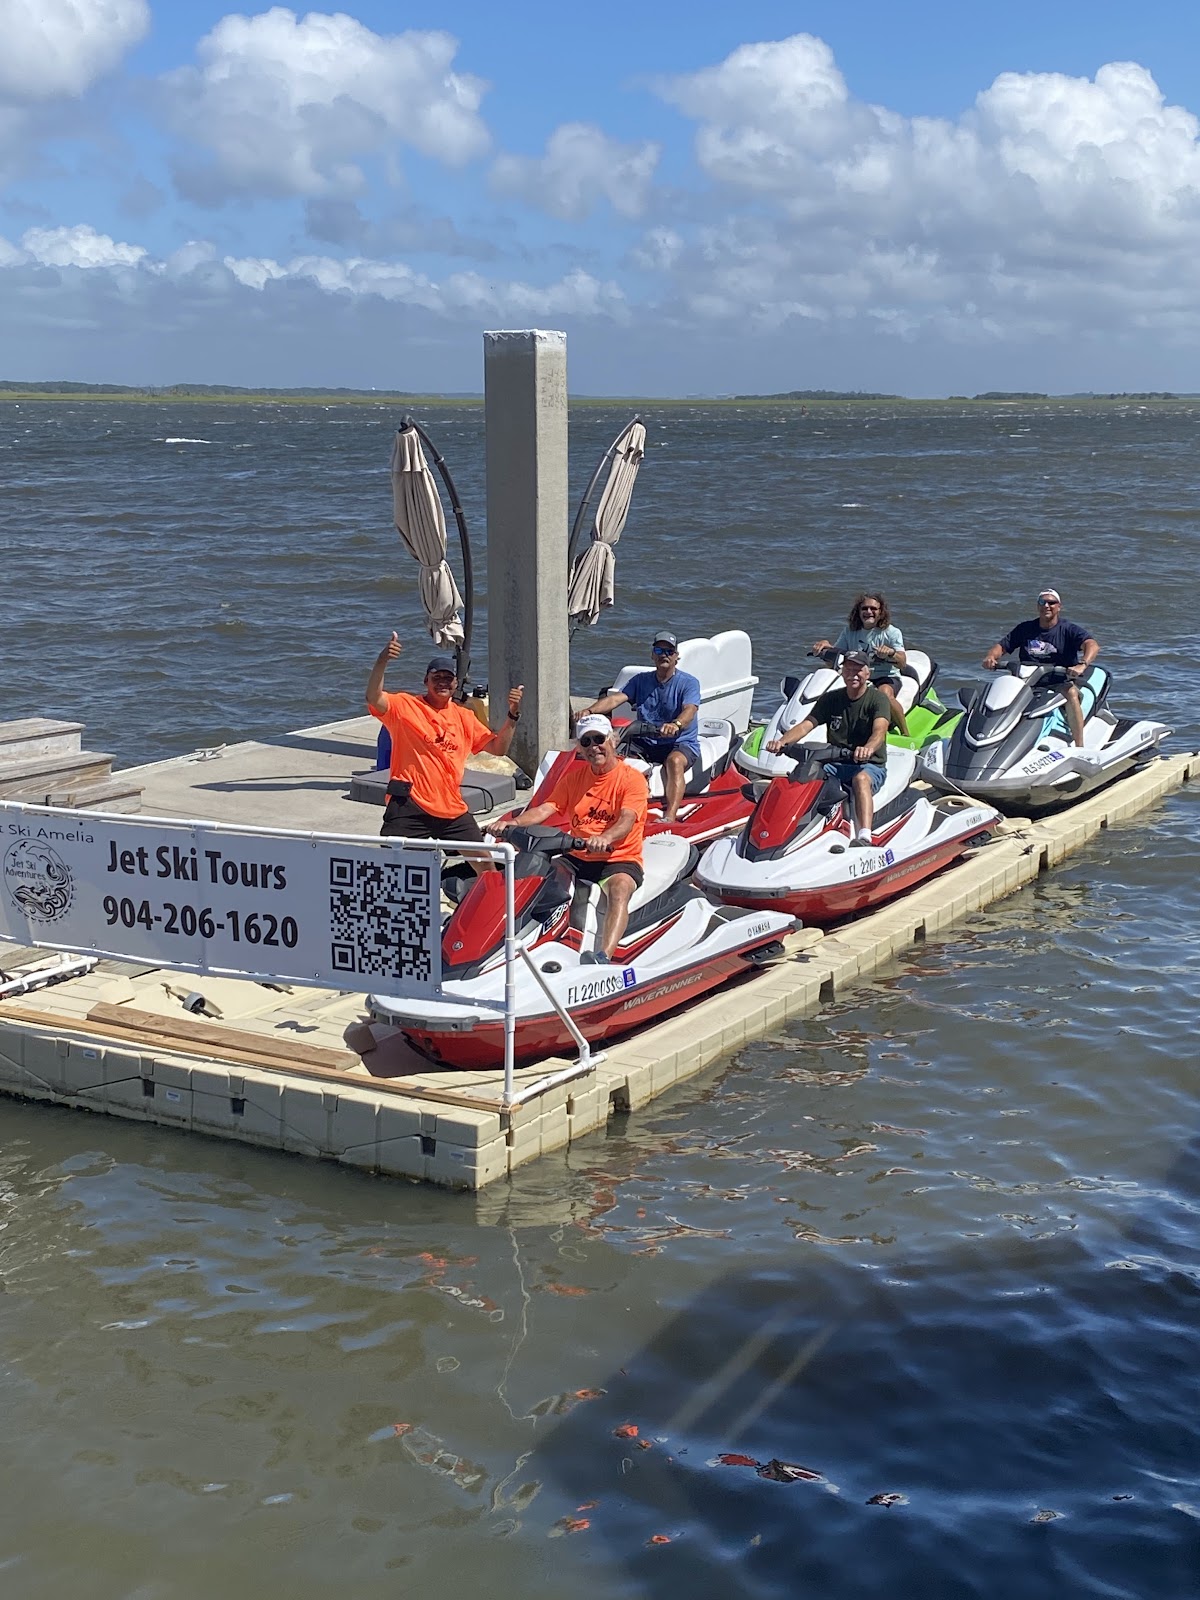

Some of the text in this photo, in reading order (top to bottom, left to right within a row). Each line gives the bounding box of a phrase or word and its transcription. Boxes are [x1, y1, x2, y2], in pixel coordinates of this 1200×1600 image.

[8, 824, 31, 837] Ski
[36, 827, 94, 843] Amelia
[107, 840, 287, 890] Jet Ski Tours
[103, 895, 298, 948] 904-206-1620
